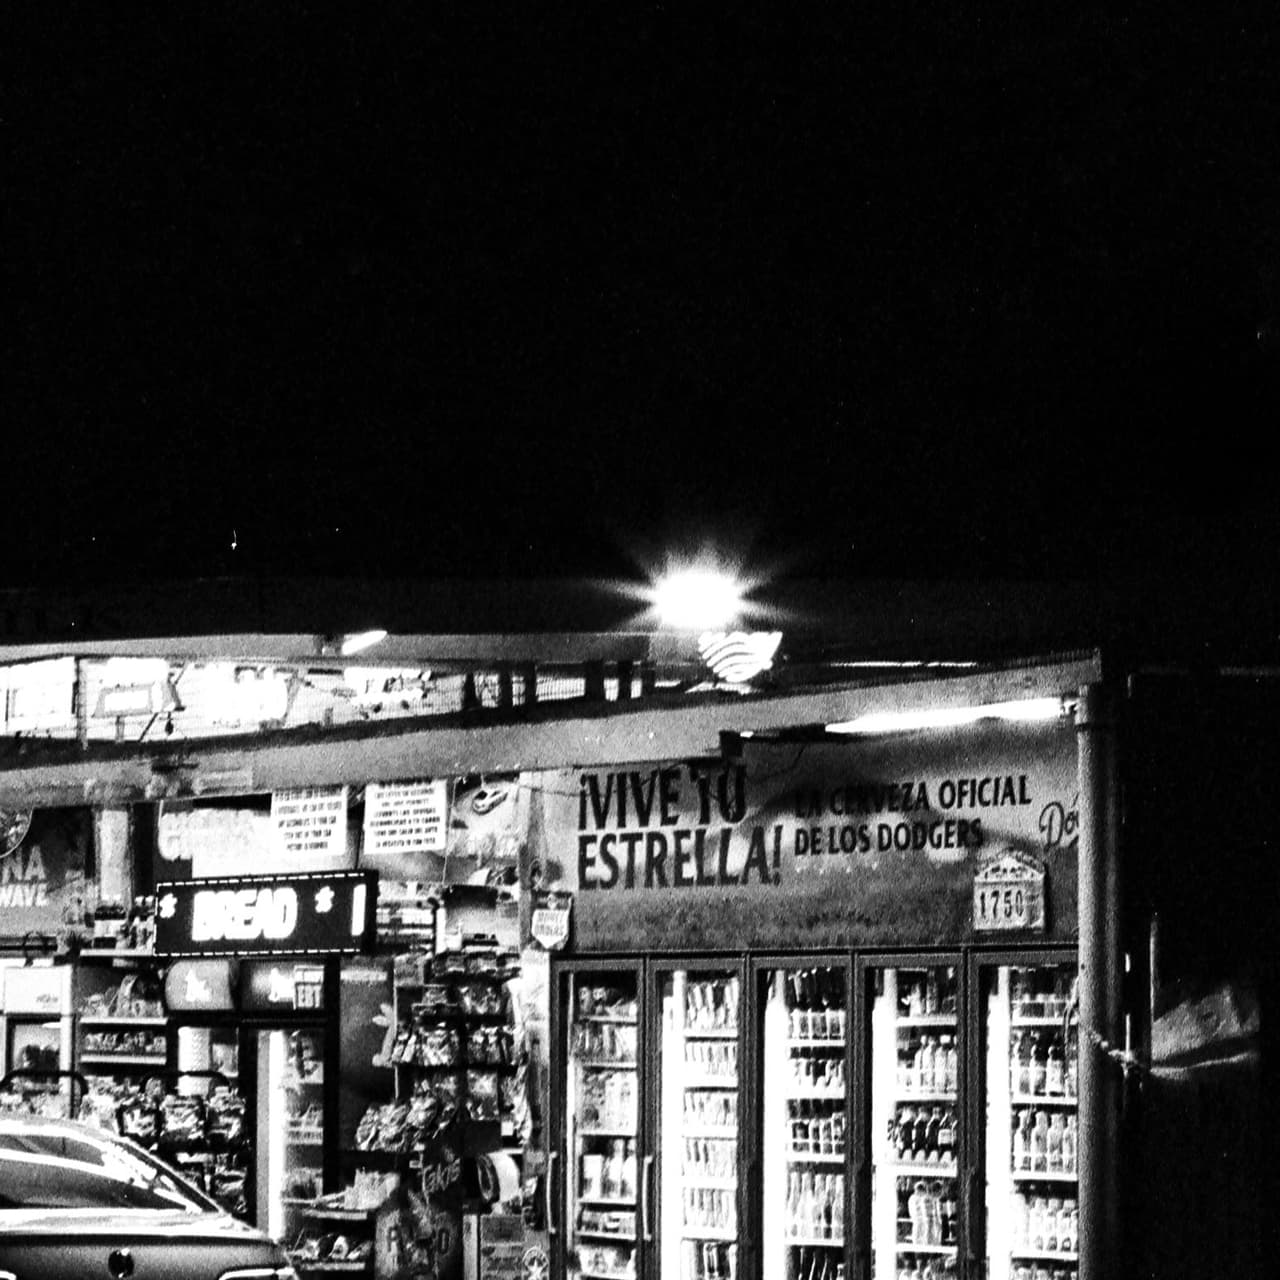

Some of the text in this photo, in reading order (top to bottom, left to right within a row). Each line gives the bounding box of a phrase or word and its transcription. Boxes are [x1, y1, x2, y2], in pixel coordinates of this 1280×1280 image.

[689, 766, 748, 824] TU
[938, 774, 1033, 810] OFICIAL
[794, 817, 985, 857] DE LOS DODGERS
[578, 824, 784, 891] ESTRELLA!
[979, 889, 1024, 919] 1750
